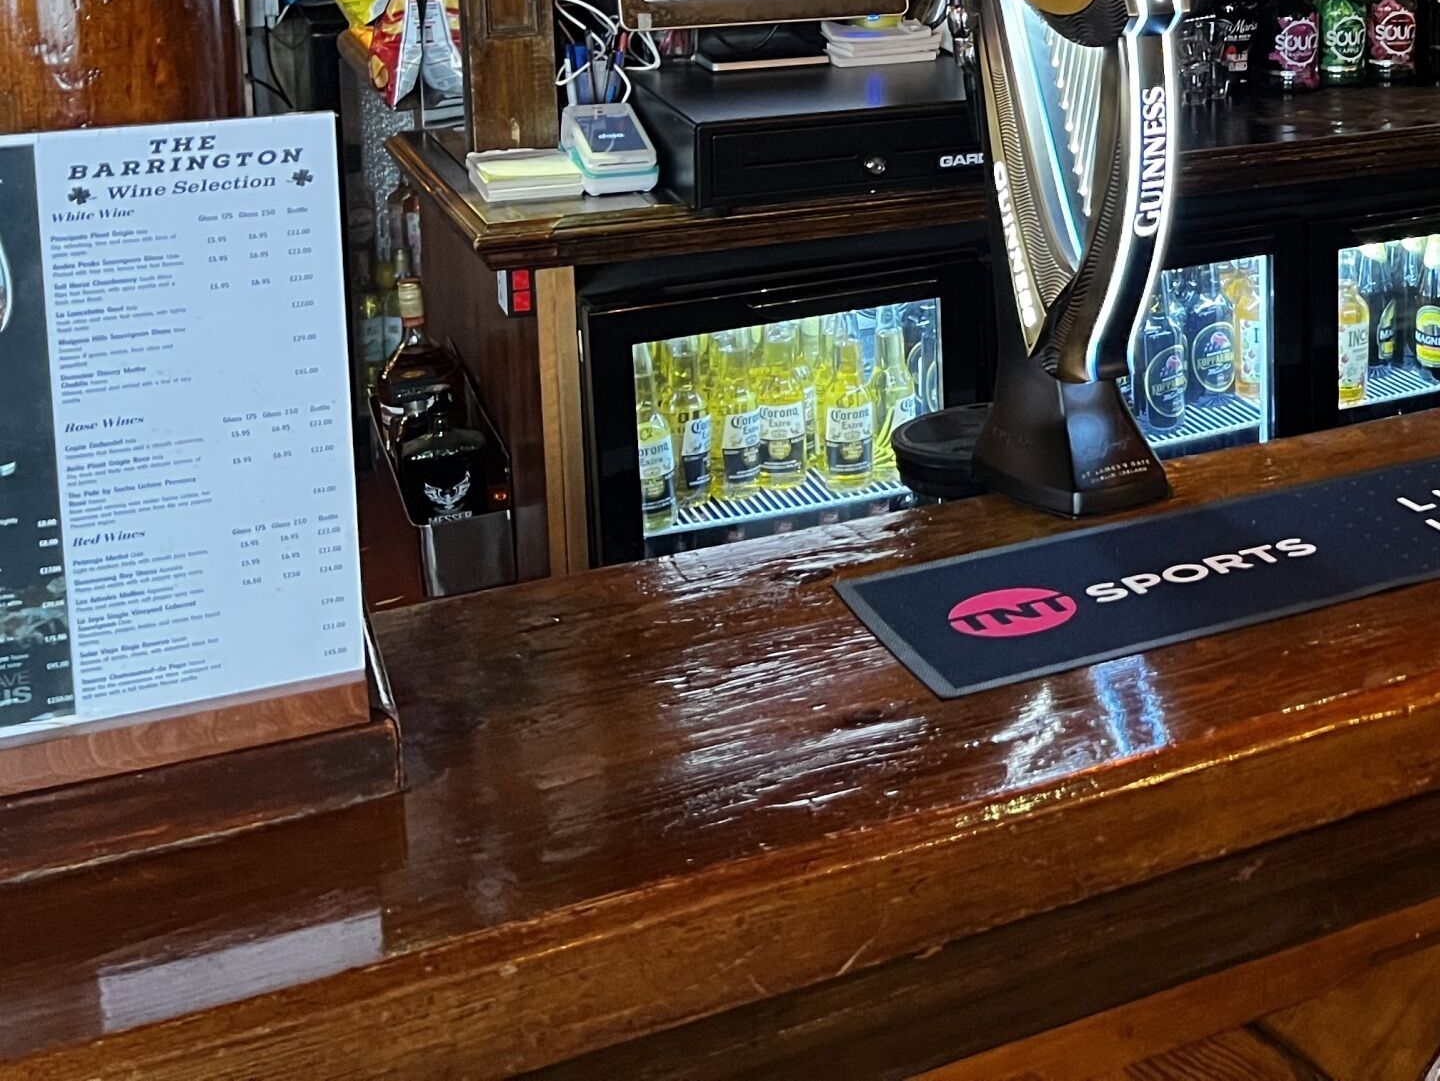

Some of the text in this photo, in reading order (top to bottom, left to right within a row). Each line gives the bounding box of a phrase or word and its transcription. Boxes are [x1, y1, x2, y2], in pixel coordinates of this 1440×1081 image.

[149, 134, 217, 155] THE
[68, 147, 304, 181] BARRINGTON
[1134, 84, 1166, 239] GUINNESS
[107, 175, 277, 202] Wine Selection
[51, 207, 135, 223] White Wine
[760, 405, 799, 420] Corona
[831, 407, 870, 423] Corona
[65, 416, 145, 433] Rose Wines
[1130, 459, 1150, 467] GATE
[73, 530, 146, 548] Red Wines
[956, 536, 1318, 632] TNT SPORTS
